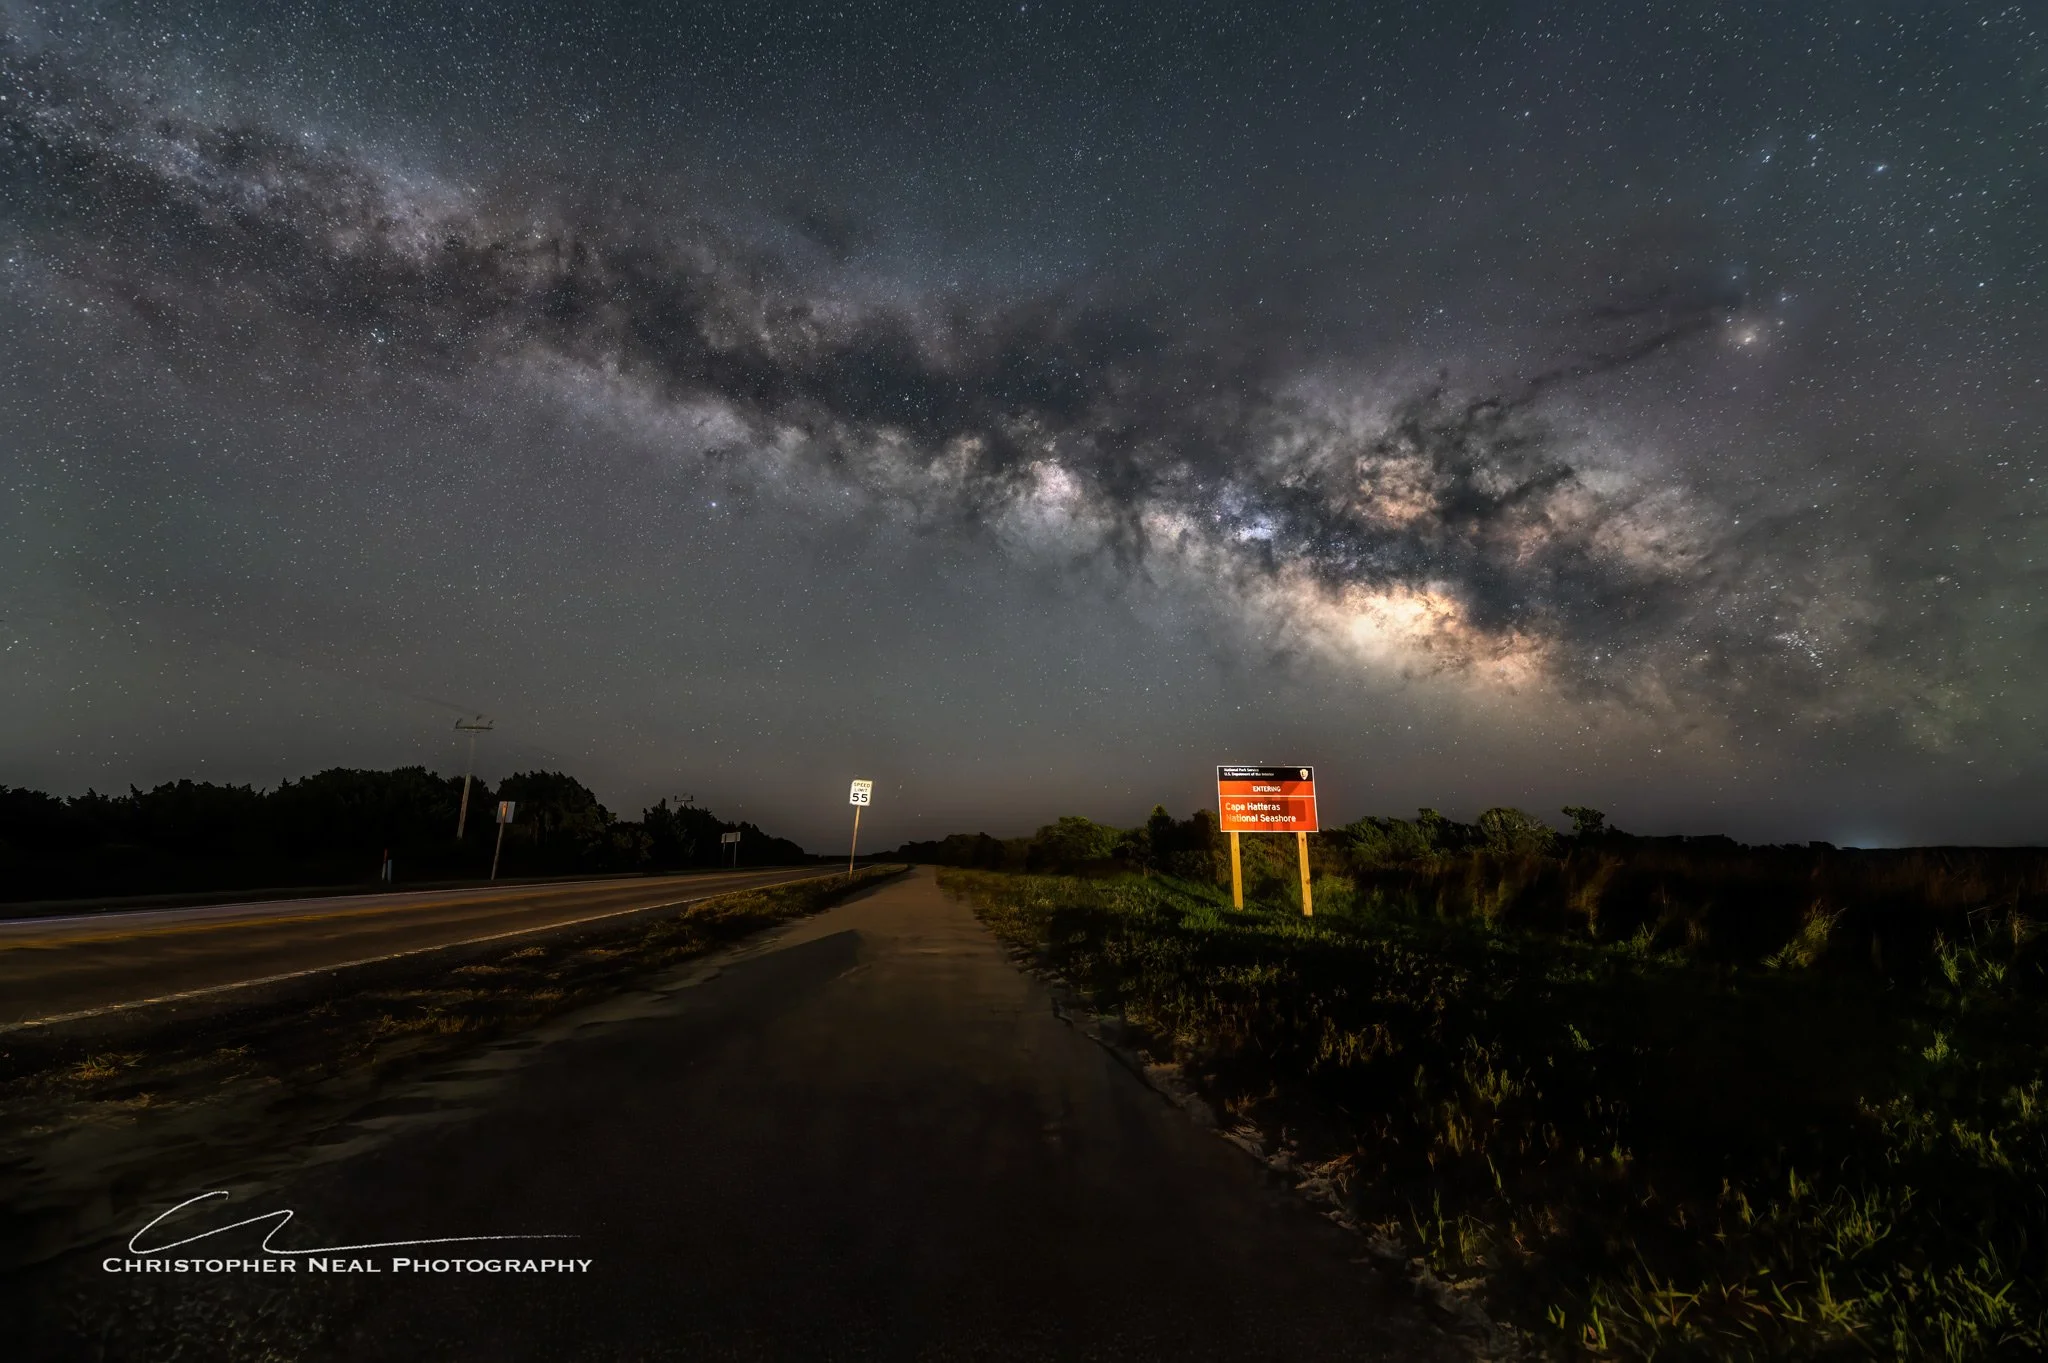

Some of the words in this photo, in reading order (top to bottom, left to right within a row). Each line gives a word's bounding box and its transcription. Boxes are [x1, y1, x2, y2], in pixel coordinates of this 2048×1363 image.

[852, 793, 868, 802] 55
[1225, 802, 1245, 812] Cape
[1247, 802, 1280, 811] Hatteras
[1226, 814, 1258, 822] National
[1260, 814, 1296, 822] Seashore
